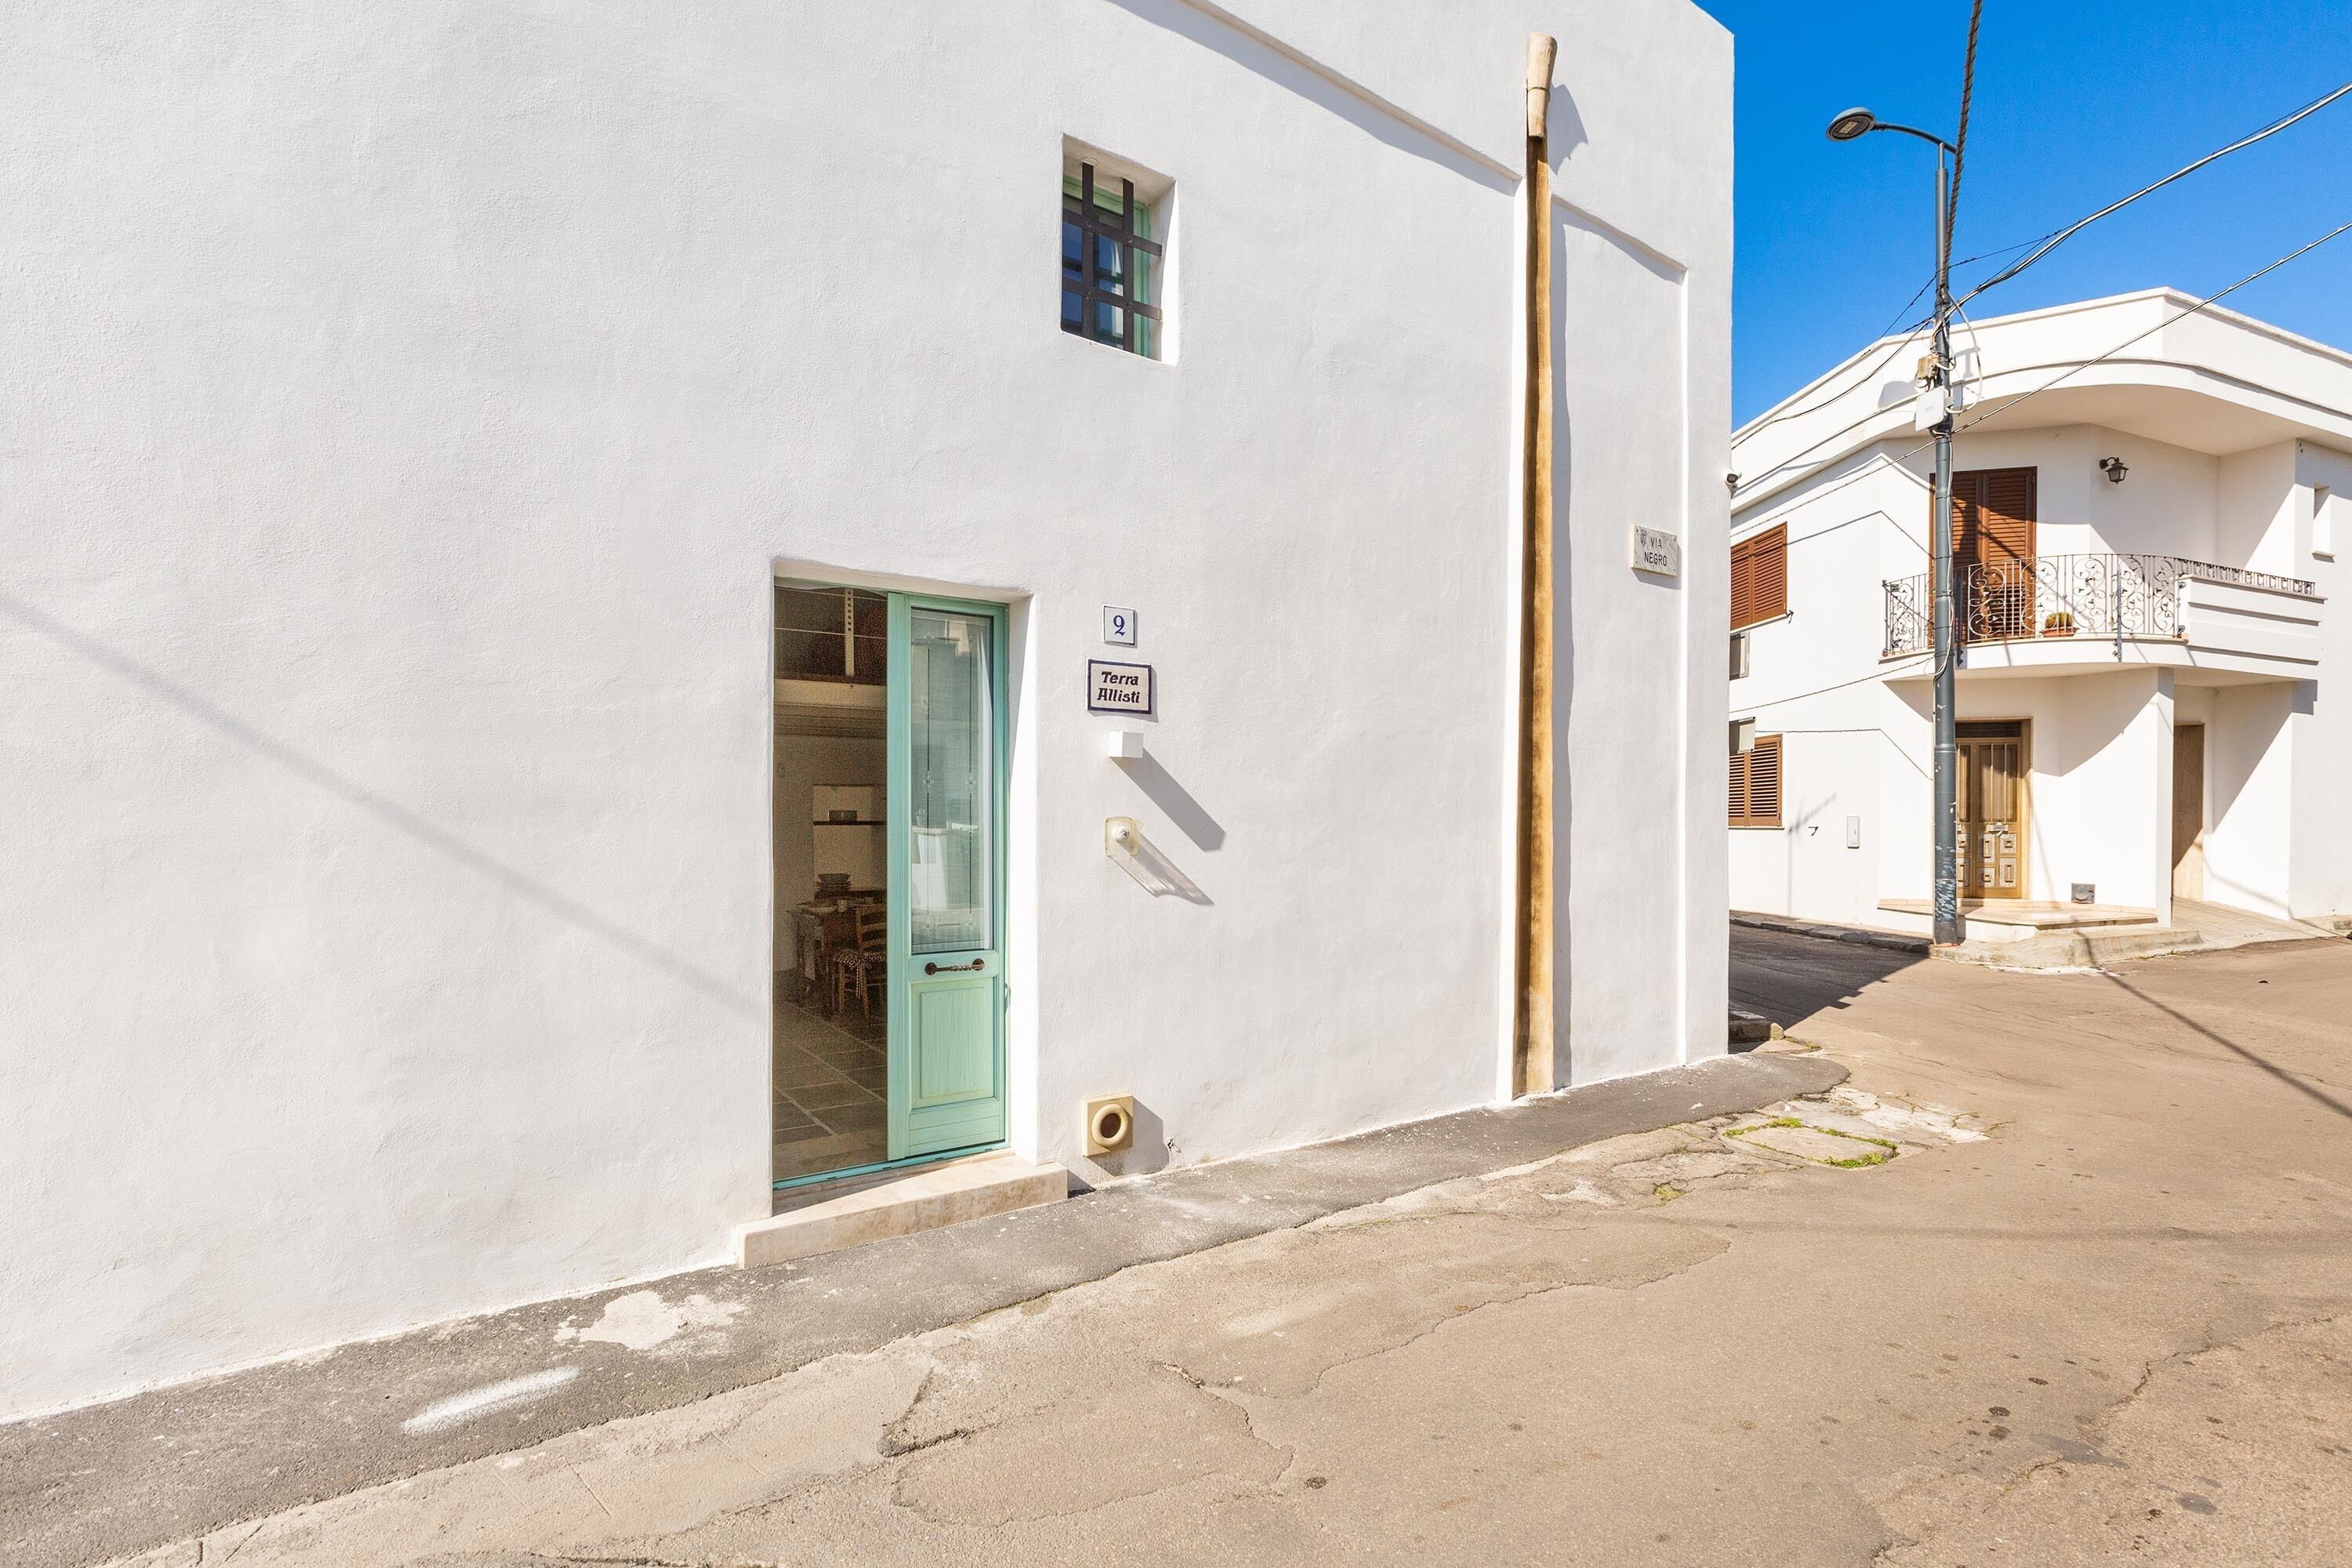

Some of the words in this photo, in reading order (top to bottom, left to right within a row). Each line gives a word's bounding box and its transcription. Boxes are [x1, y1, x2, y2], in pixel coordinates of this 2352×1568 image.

[1650, 537, 1662, 549] VIA
[1644, 551, 1668, 566] NEGRO
[1102, 671, 1139, 685] Terra
[1097, 688, 1141, 703] Allisti
